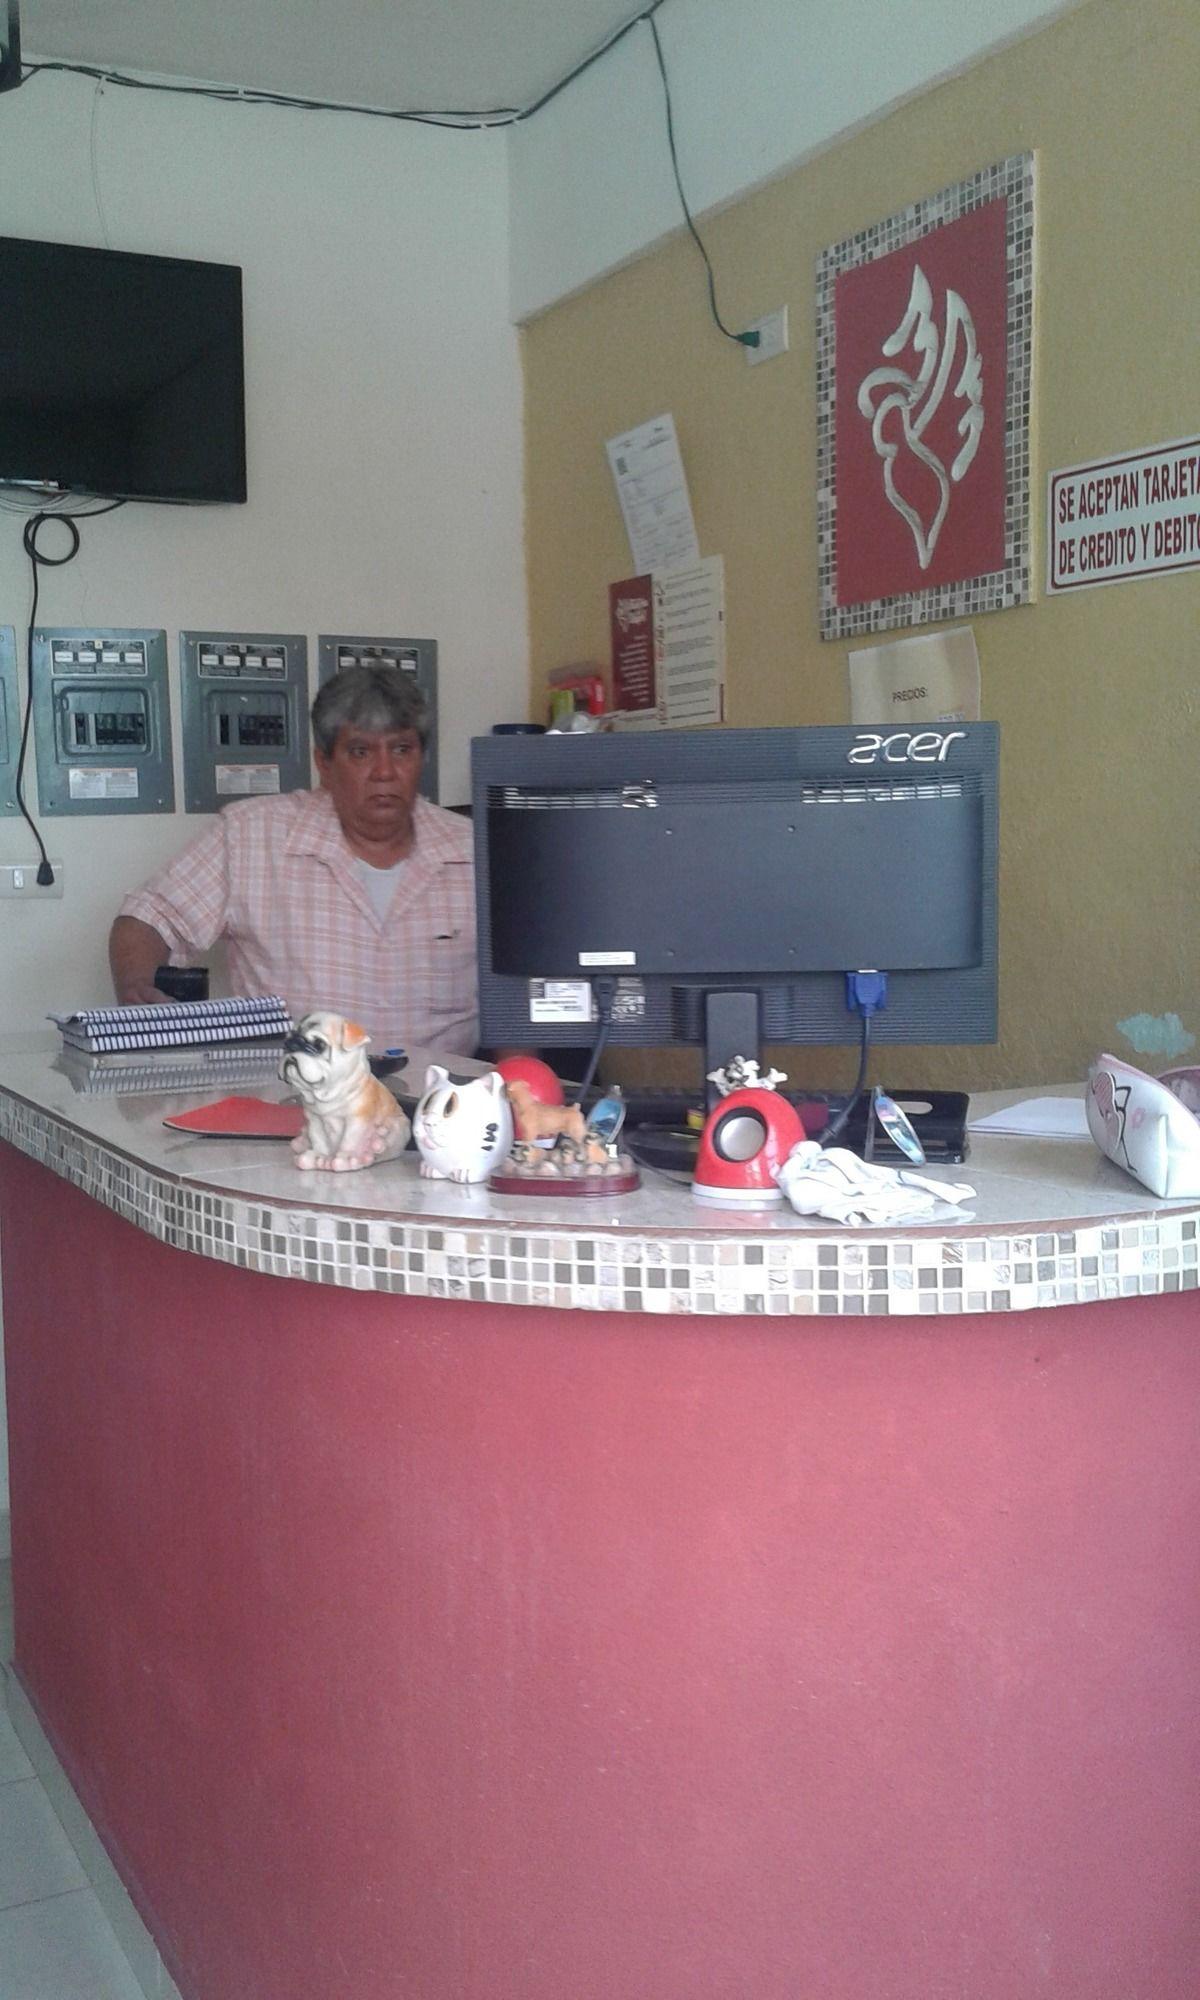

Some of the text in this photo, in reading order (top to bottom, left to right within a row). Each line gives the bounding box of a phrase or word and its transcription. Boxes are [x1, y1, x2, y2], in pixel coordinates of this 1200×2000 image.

[1059, 486, 1075, 524] SE
[1079, 471, 1139, 520] ACEPTAN
[1059, 538, 1075, 576] DE
[1079, 526, 1136, 572] CREDITO
[1141, 523, 1150, 560] Y
[847, 731, 967, 763] acer
